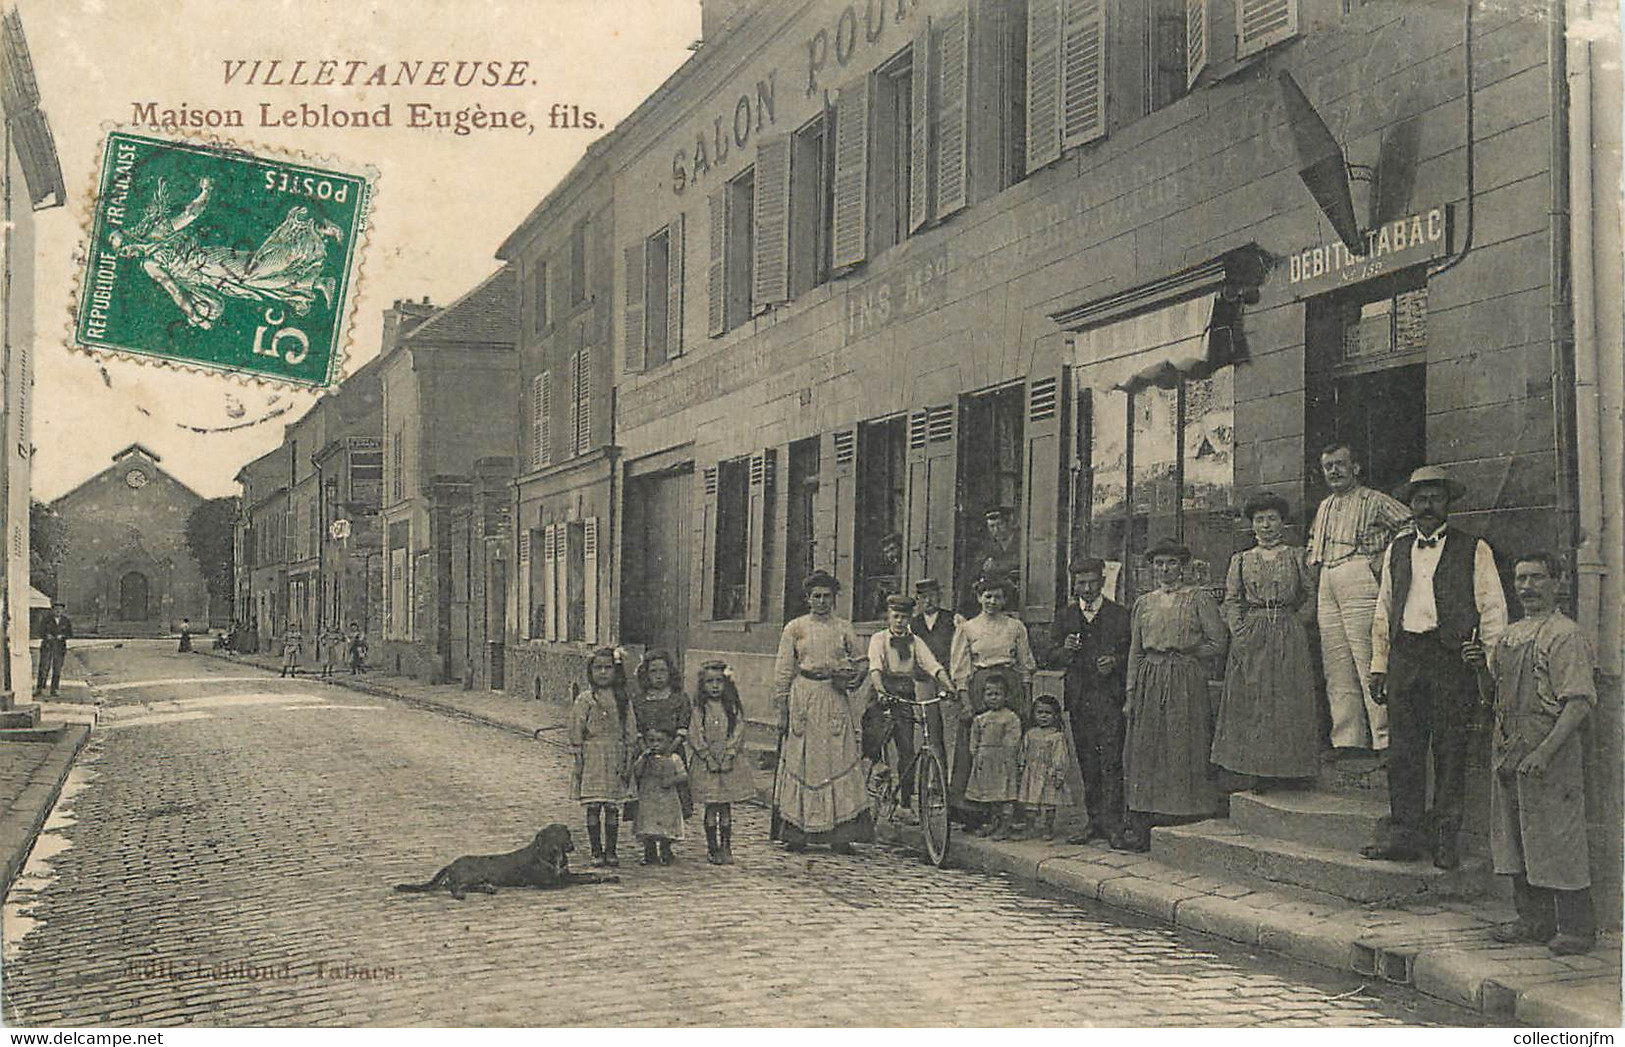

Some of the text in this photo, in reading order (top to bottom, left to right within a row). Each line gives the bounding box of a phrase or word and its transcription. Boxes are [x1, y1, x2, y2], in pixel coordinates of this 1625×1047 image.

[672, 68, 778, 196] SALON
[264, 170, 349, 204] POSTES
[1366, 208, 1442, 259] TABAC
[87, 251, 118, 340] REPUBLIQUE
